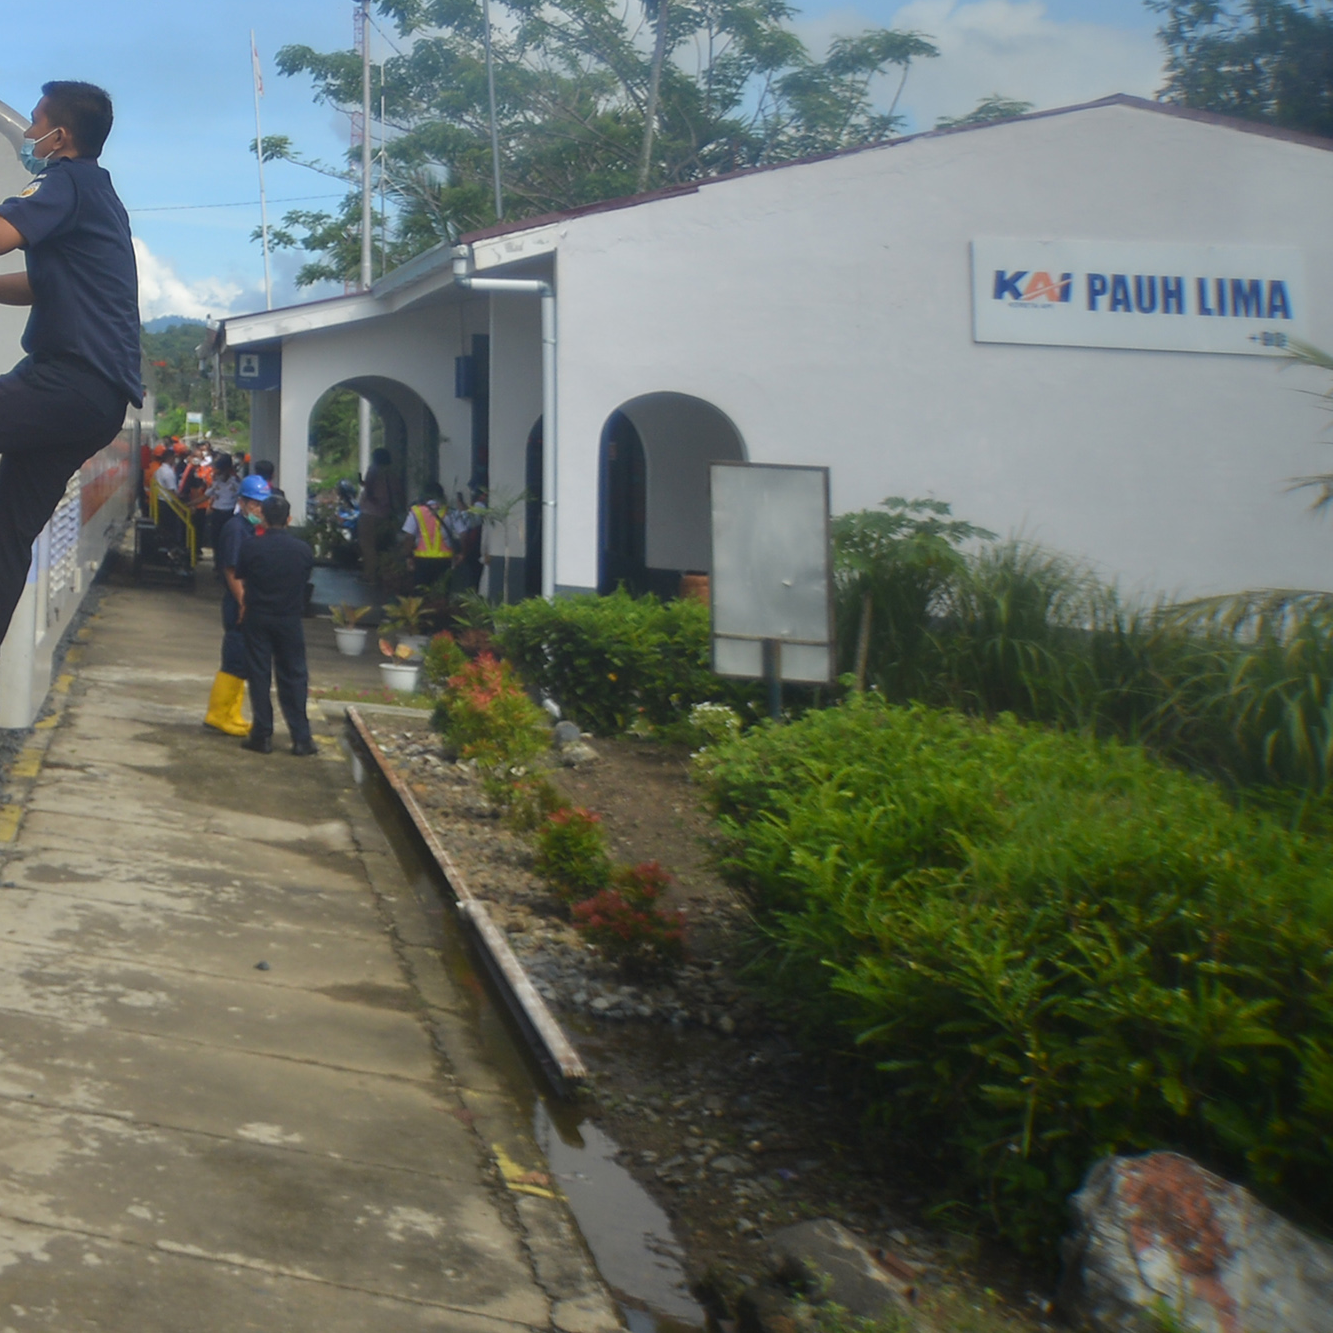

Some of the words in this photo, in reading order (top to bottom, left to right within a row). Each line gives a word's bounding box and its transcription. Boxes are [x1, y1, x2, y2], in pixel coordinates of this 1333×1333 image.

[992, 269, 1073, 302] KAI
[1086, 272, 1186, 315] PAUH
[1196, 277, 1294, 319] LIMA
